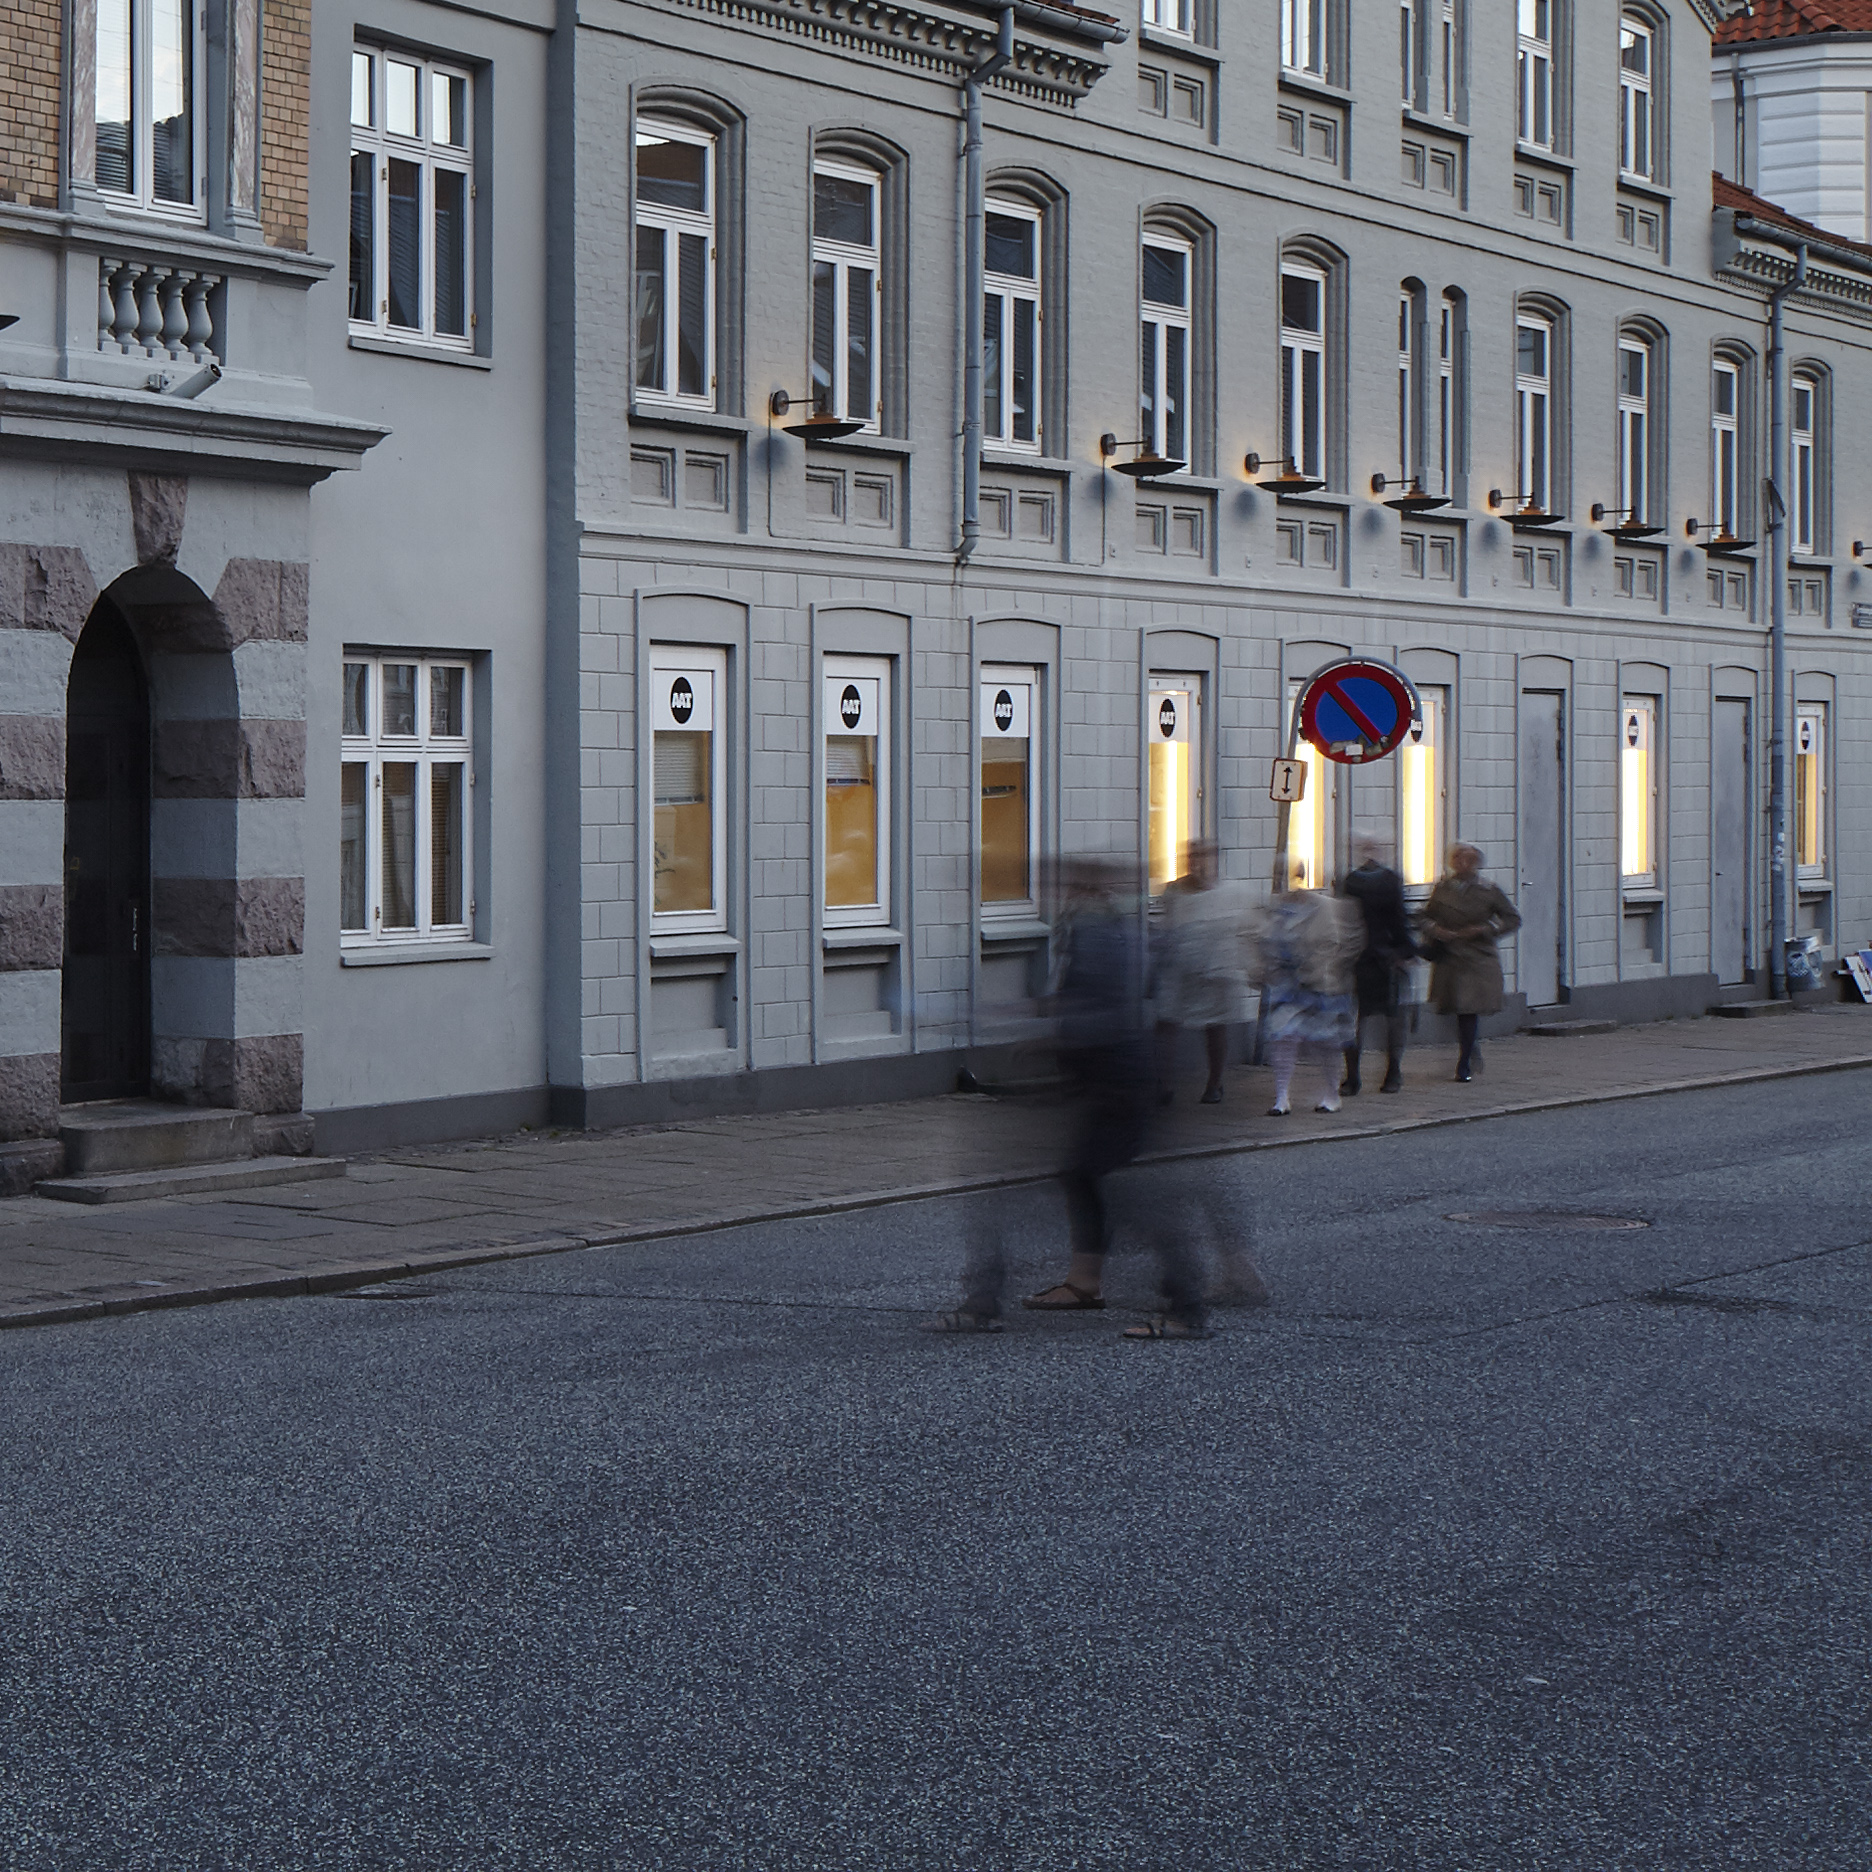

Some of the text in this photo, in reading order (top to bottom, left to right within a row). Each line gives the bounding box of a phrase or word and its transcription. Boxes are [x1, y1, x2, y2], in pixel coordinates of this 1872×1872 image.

[671, 692, 693, 709] AAT
[841, 699, 861, 715] AAT
[995, 703, 1013, 718] AAT
